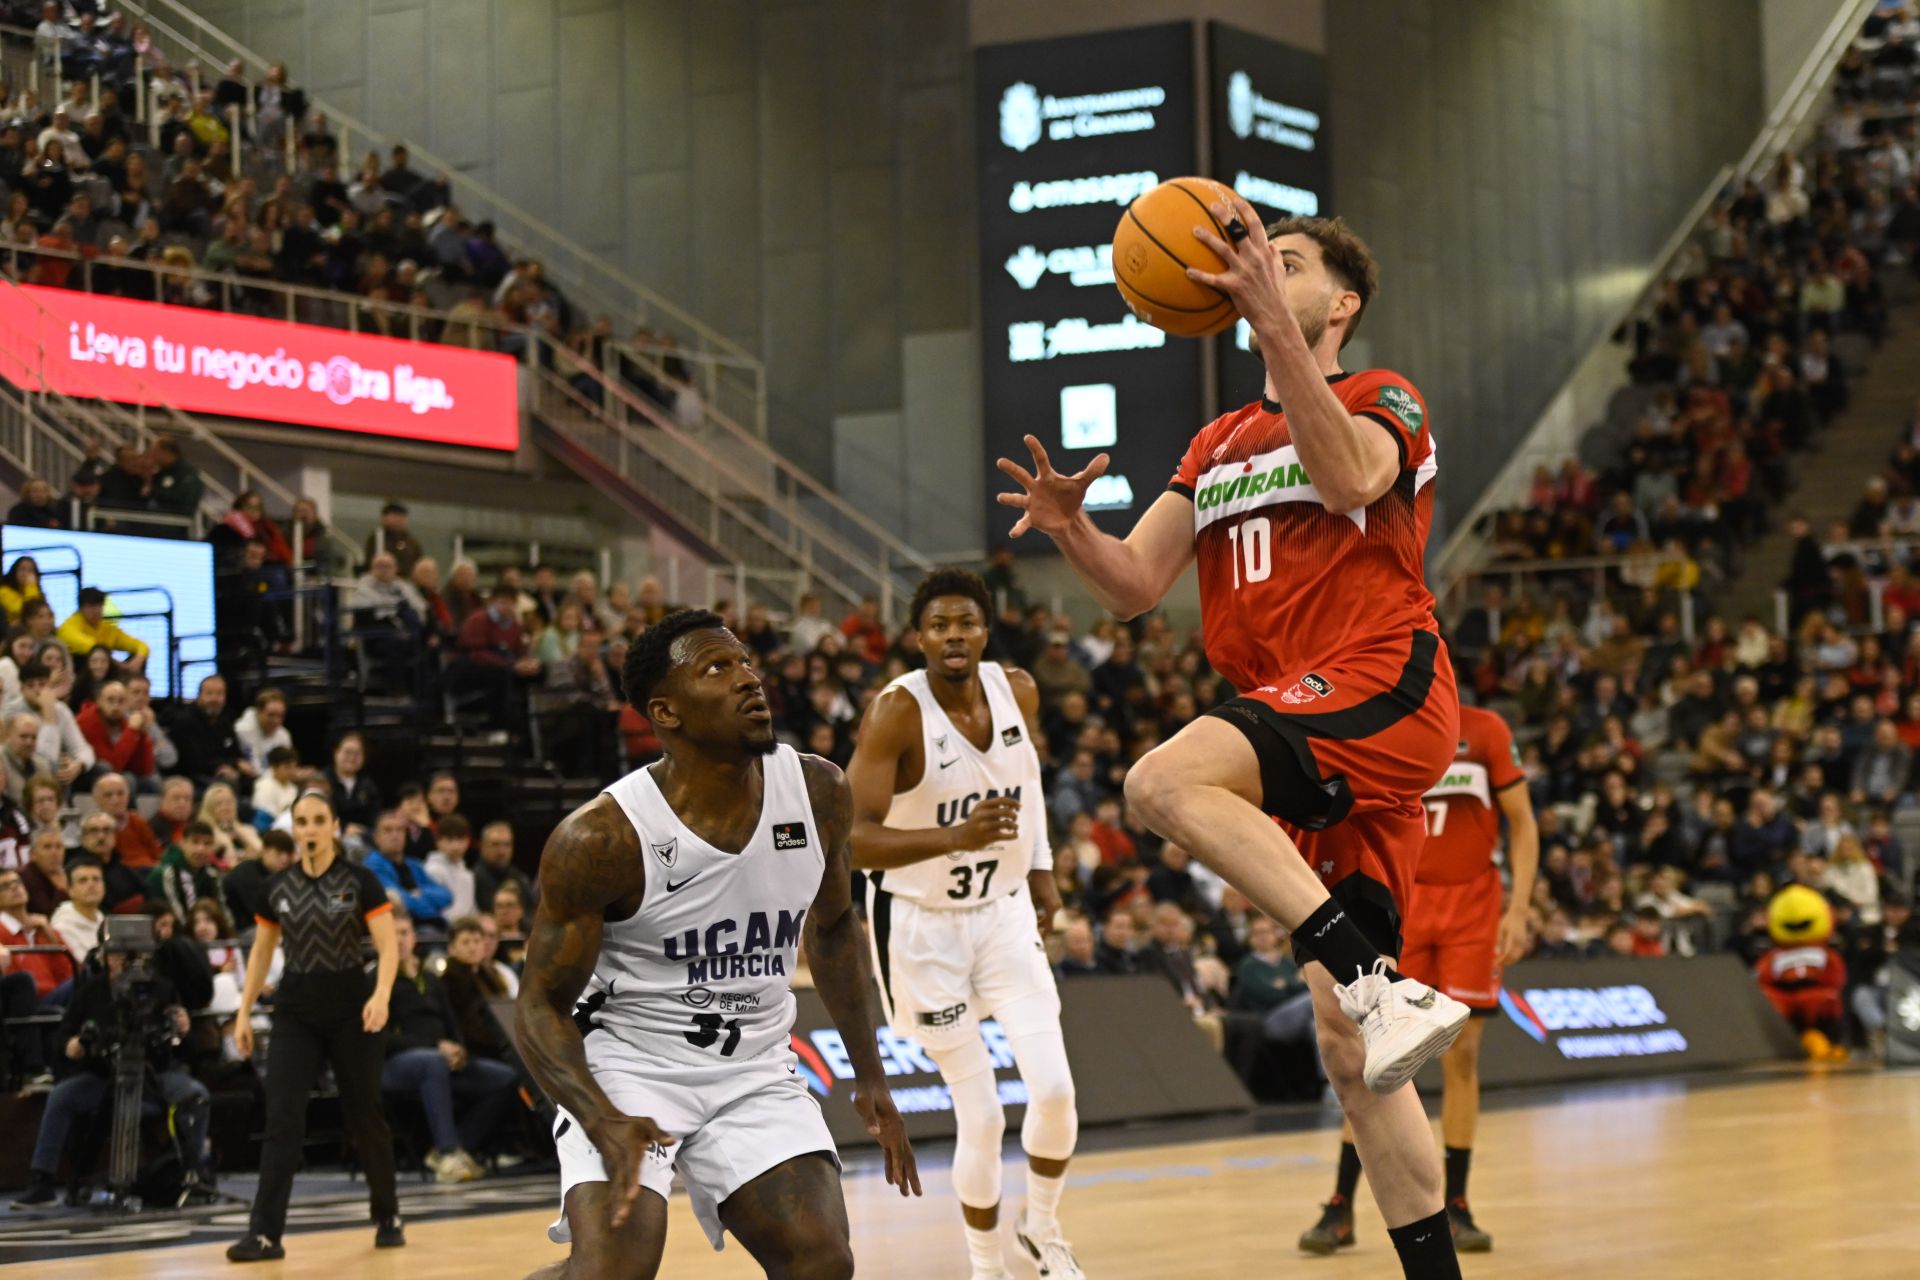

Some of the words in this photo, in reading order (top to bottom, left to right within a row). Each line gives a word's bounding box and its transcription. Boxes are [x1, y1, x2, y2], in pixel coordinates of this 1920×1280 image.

[69, 320, 146, 369] Lleva
[152, 335, 186, 374] tu
[191, 346, 304, 390] negocio
[1228, 516, 1271, 590] 10
[1304, 676, 1324, 692] acb
[776, 832, 790, 841] liga
[777, 838, 806, 848] endesa
[947, 860, 998, 900] 37
[664, 909, 806, 961] UCAM
[687, 954, 786, 985] MURCIA
